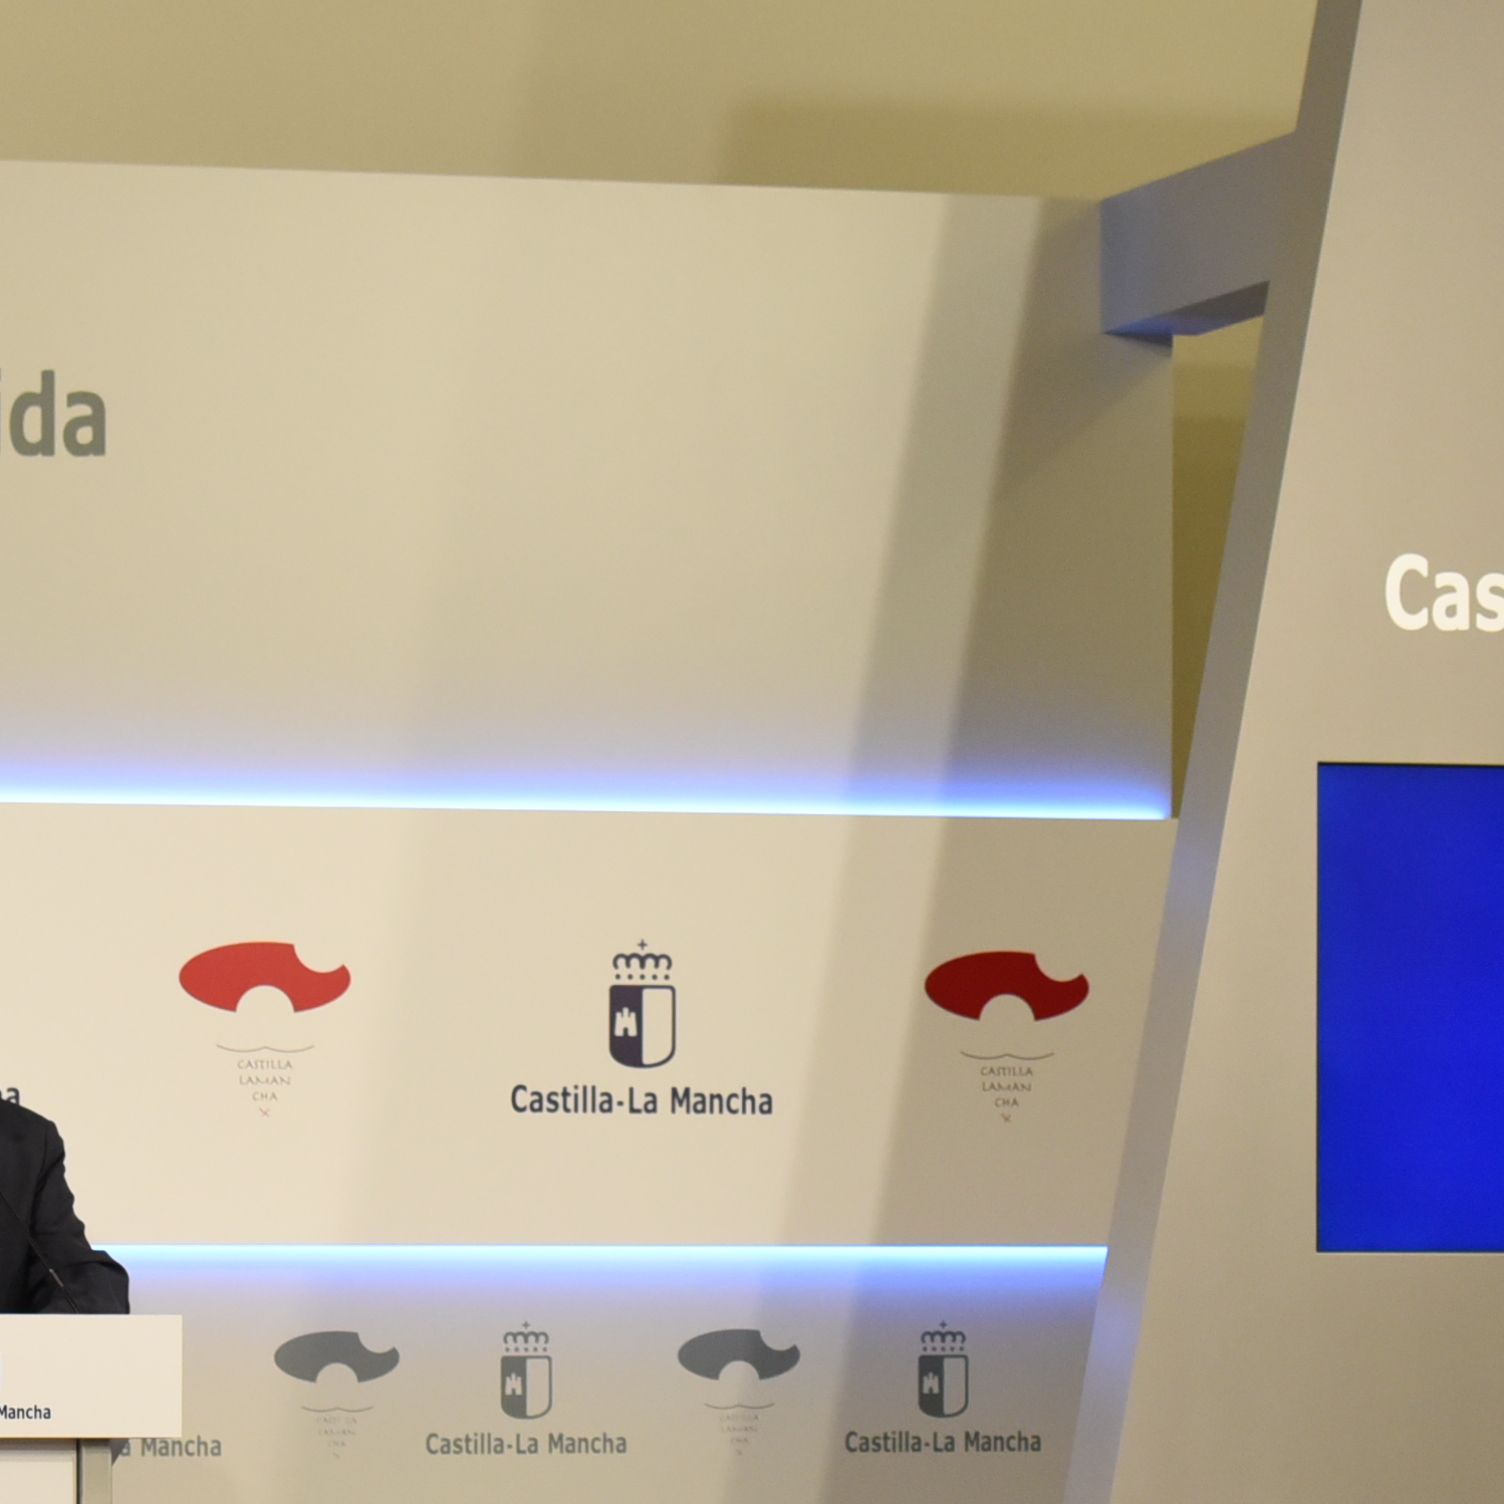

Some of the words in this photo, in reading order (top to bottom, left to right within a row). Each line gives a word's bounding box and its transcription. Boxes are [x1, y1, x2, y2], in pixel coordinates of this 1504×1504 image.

[510, 1084, 658, 1115] Castilla-La
[671, 1087, 774, 1116] Mancha
[141, 1434, 222, 1457] Mancha
[426, 1433, 539, 1456] Castilla-La
[548, 1433, 628, 1456] Mancha
[845, 1431, 956, 1454] Castilla-La
[965, 1431, 1042, 1454] Mancha
